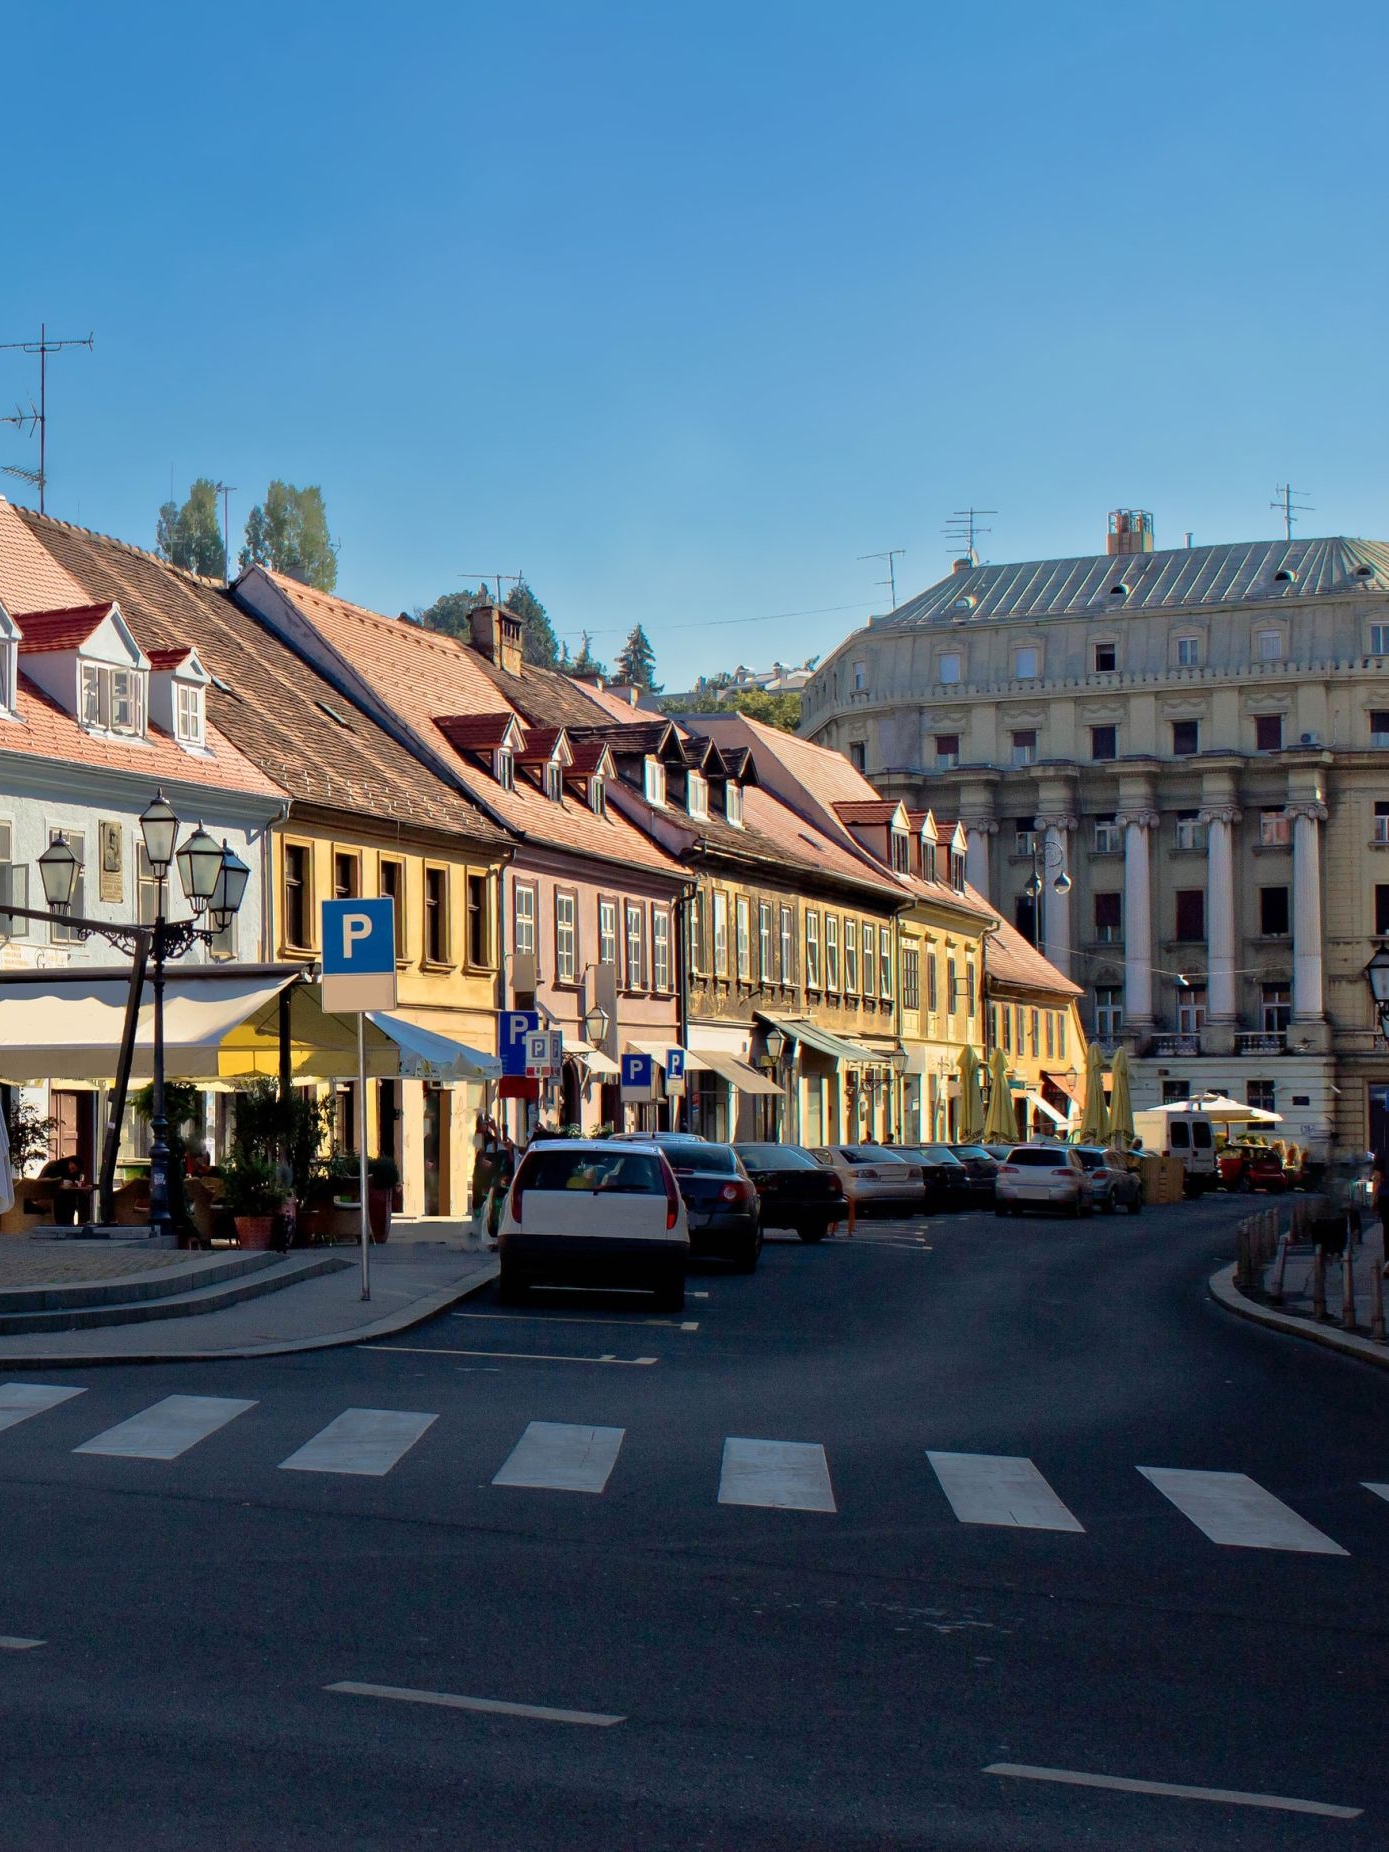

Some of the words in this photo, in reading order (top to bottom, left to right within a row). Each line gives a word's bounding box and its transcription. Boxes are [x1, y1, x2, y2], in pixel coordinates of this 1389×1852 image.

[343, 914, 372, 958] P
[510, 1015, 529, 1044] P
[534, 1041, 543, 1056] P
[630, 1060, 643, 1080] P
[672, 1054, 680, 1074] P
